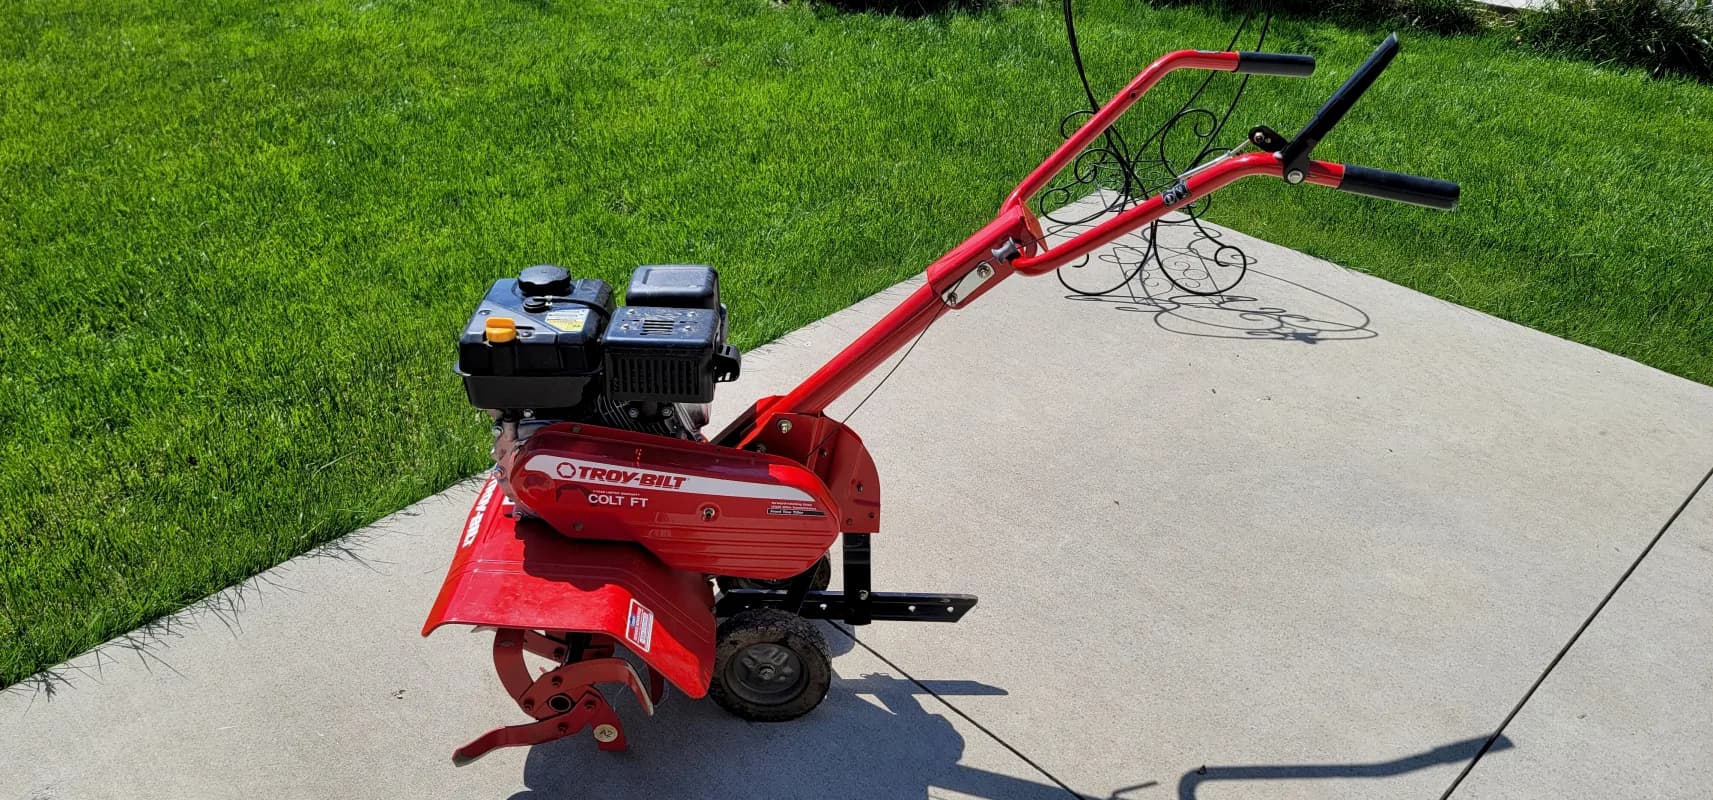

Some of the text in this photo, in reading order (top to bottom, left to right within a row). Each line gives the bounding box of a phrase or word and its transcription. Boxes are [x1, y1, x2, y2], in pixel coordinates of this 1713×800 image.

[578, 466, 687, 489] TROY-BILT
[462, 476, 498, 548] ROY-BILT
[588, 493, 648, 508] COLT FT
